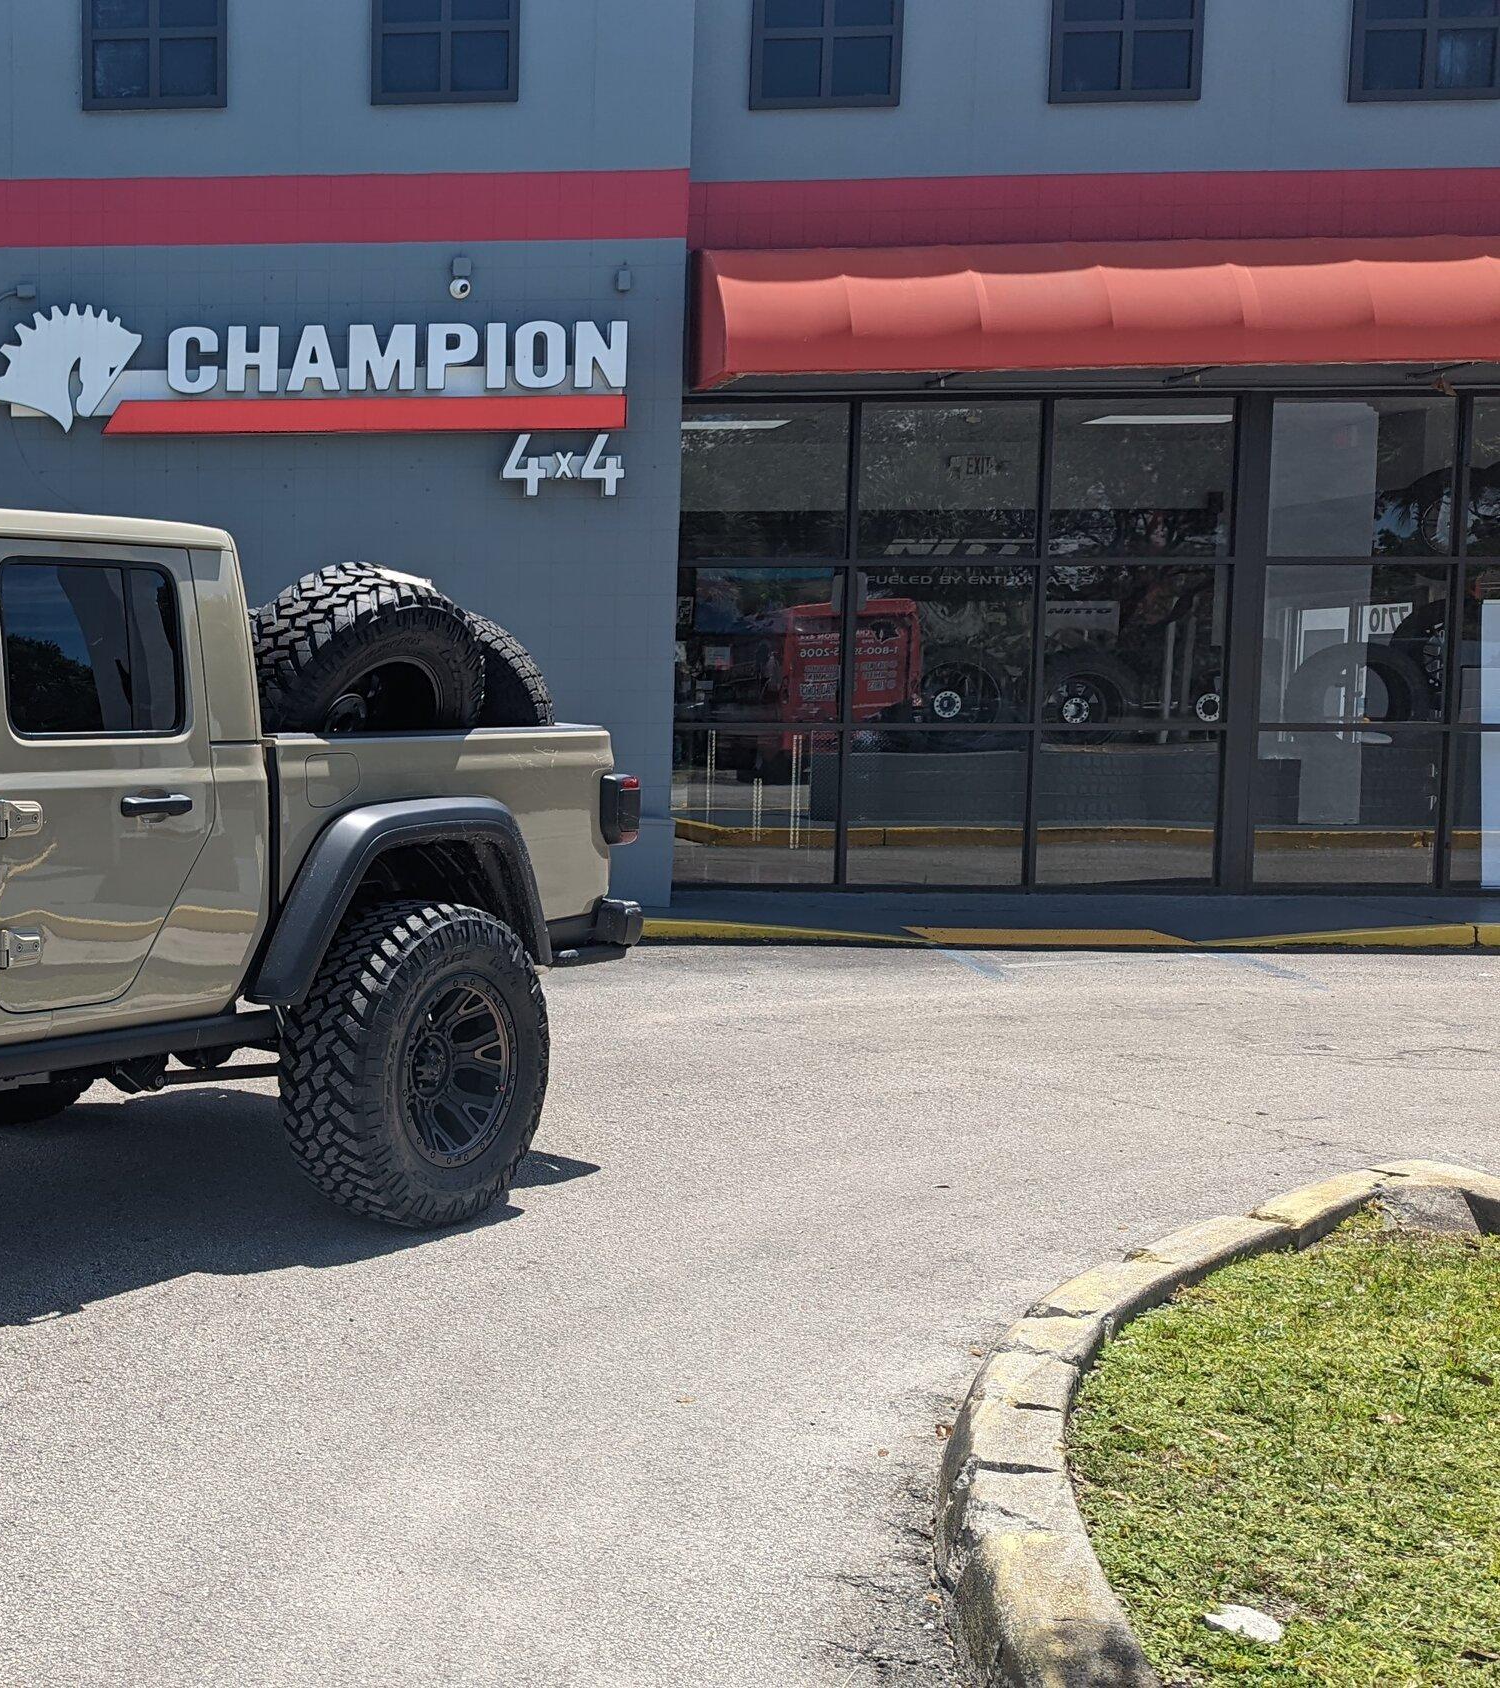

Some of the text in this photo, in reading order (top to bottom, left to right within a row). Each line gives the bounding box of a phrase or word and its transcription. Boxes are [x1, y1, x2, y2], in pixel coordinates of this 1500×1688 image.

[167, 320, 628, 394] CHAMPION
[502, 433, 626, 497] 4x4
[966, 456, 991, 475] EXIT
[866, 575, 933, 585] FUELED
[939, 575, 962, 585] BY
